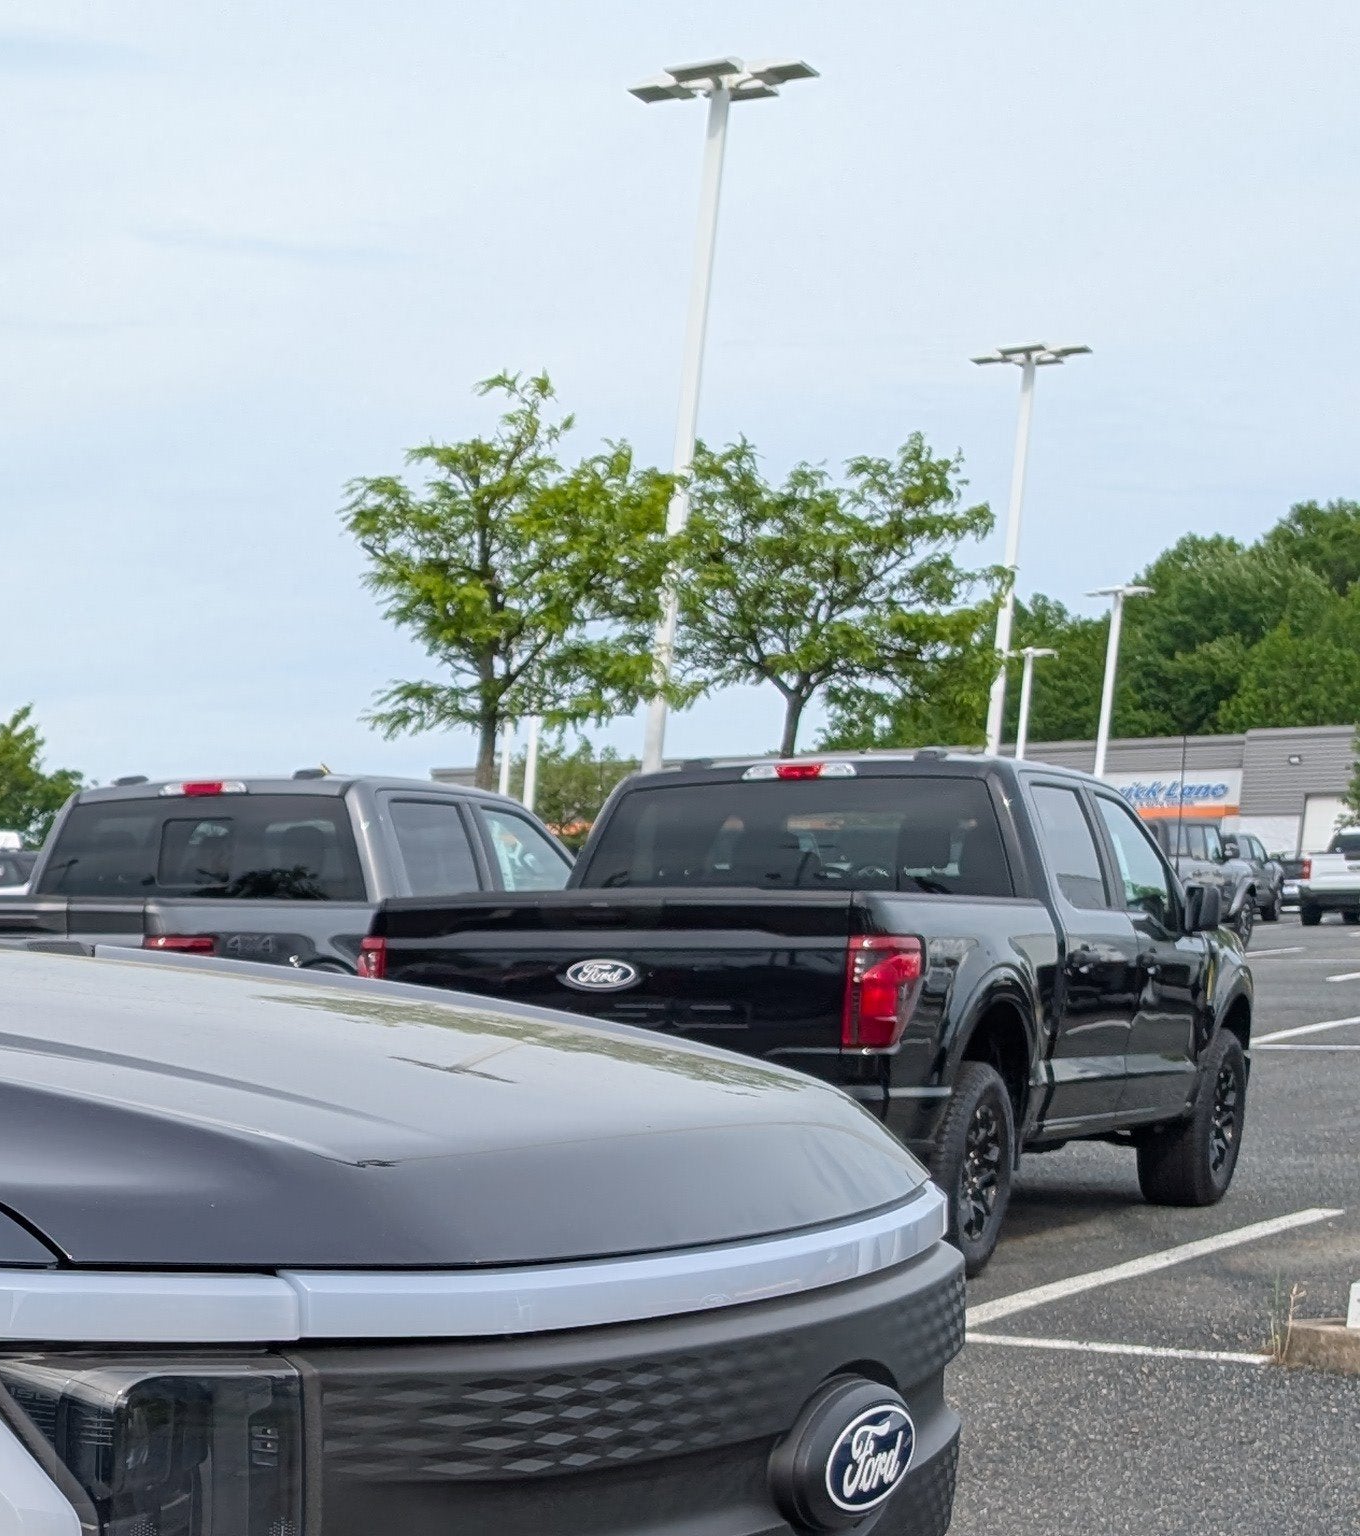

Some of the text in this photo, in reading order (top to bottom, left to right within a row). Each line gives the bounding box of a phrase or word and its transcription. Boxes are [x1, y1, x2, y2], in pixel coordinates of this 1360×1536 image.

[1164, 780, 1229, 798] Lane
[577, 962, 624, 983] Ford
[842, 1420, 904, 1499] Ford
